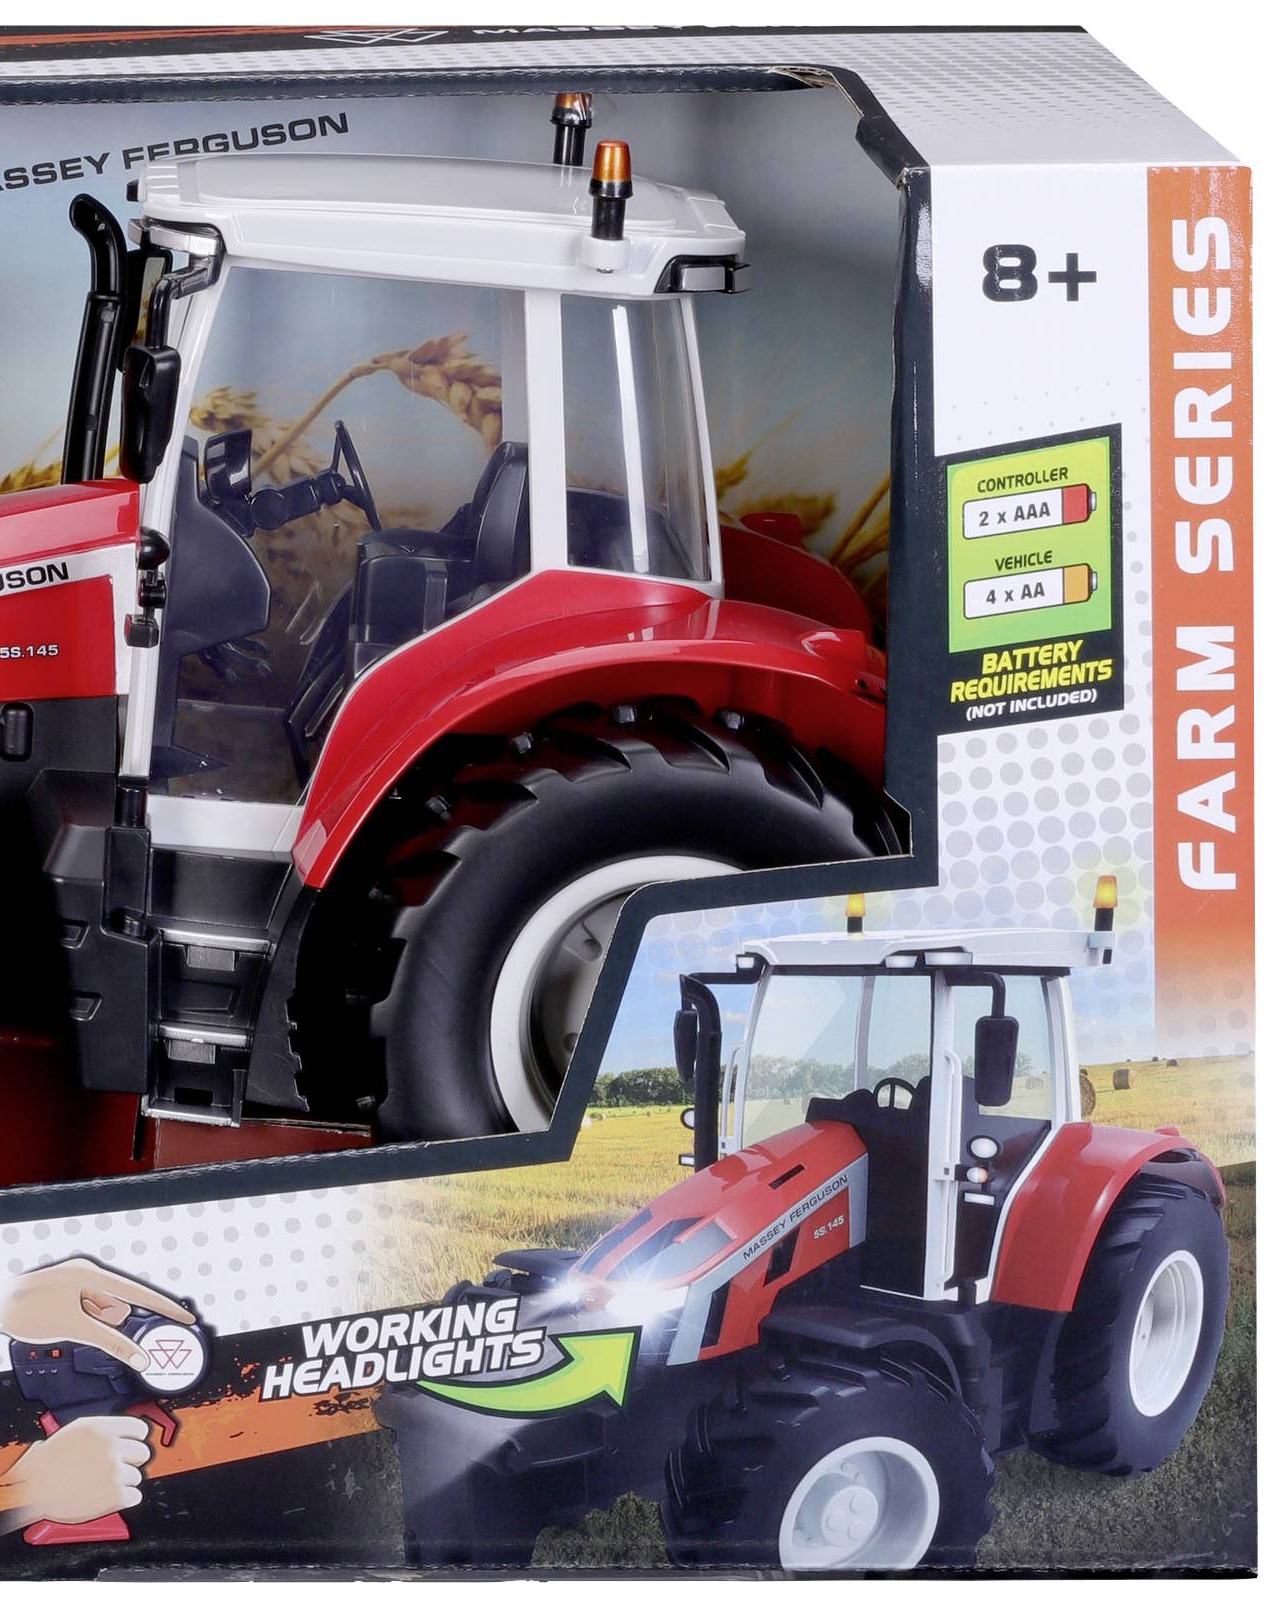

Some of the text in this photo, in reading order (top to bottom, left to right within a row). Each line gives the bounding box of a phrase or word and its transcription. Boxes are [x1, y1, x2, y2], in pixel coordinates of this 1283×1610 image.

[122, 112, 349, 170] FERGUSON
[982, 244, 1097, 302] 8+
[977, 467, 1069, 493] CONTROLLER
[978, 502, 1051, 527] 2 x AAA
[995, 550, 1053, 571] VEHICLE
[1171, 216, 1237, 891] FARM SERIES
[986, 582, 1046, 605] 4 x AA
[0, 644, 59, 659] 5S.145
[982, 640, 1083, 675] BATTERY
[950, 659, 1113, 703] REQUIREMENTS
[966, 688, 1097, 721] (NOT INCLUDED)
[743, 1174, 848, 1260] MASSEY FERGUSON
[301, 1298, 519, 1358] WORKING
[261, 1330, 544, 1400] HEADLIGHTS
